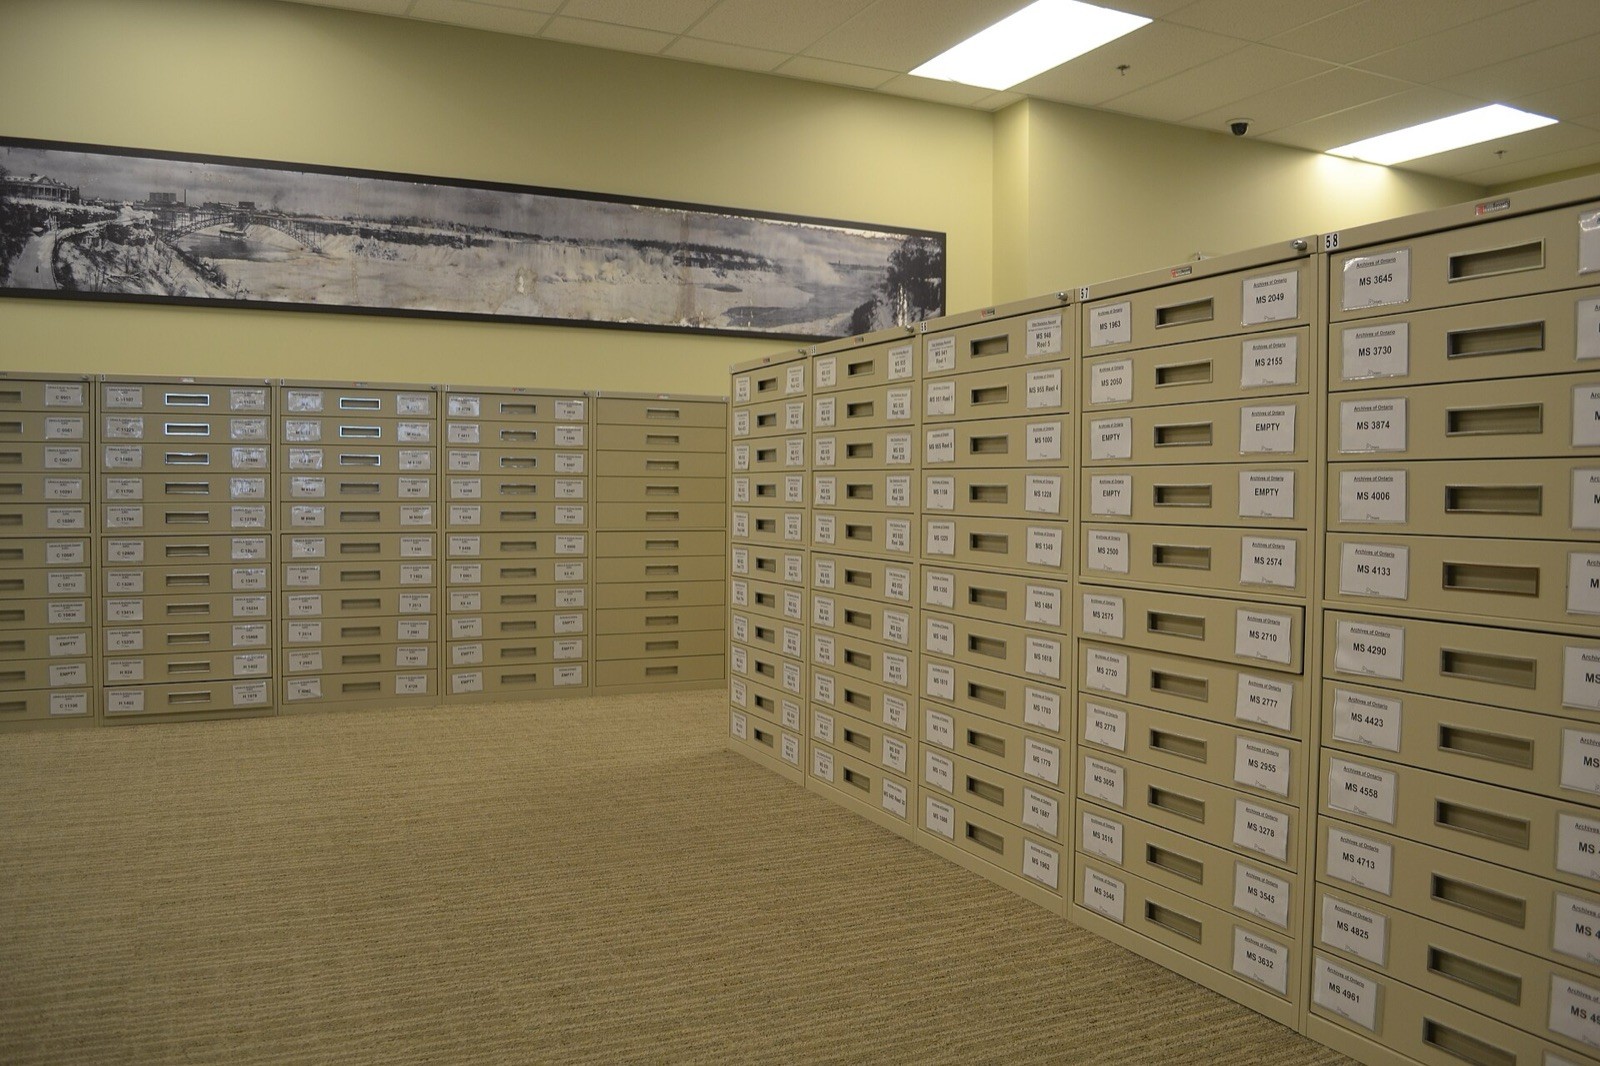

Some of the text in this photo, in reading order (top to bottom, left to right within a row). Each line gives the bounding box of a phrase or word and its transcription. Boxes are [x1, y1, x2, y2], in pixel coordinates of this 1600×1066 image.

[1325, 234, 1338, 248] 58
[1359, 273, 1393, 286] MS 3645
[1255, 292, 1285, 305] MS 2049
[1100, 320, 1121, 330] MS 1963
[1358, 345, 1392, 357] MS 3730
[1254, 357, 1283, 367] MS 2155
[1101, 378, 1123, 387] MS 2050
[1255, 423, 1280, 432] EMPTY
[1356, 420, 1390, 430] MS 3874
[1102, 433, 1121, 442] EMPTY
[1103, 489, 1121, 498] EMPTY
[1255, 488, 1279, 497] EMPTY
[1356, 491, 1390, 501] MS 4006
[1097, 547, 1106, 555] MS
[1254, 556, 1282, 567] MS 2574
[1357, 564, 1391, 576] MS 4133
[1093, 610, 1101, 618] MS
[1249, 630, 1277, 642] MS 2710
[1353, 643, 1387, 656] MS 4290
[1034, 653, 1041, 661] MS
[1096, 666, 1118, 677] MS 2720
[1585, 672, 1600, 684] MS
[1250, 695, 1278, 709] MS 2777
[1033, 704, 1040, 712] MS
[1095, 720, 1104, 729] MS
[1351, 712, 1384, 728] MS 4423
[1032, 755, 1040, 764] MS
[1583, 756, 1600, 768] MS
[1248, 758, 1276, 773] MS 2955
[1094, 775, 1102, 783] MS
[1345, 782, 1378, 799] MS 4558
[1031, 806, 1039, 814] MS
[1092, 830, 1101, 839] MS
[1247, 821, 1275, 838] MS 3278
[1578, 841, 1595, 854] MS
[1031, 857, 1039, 866] MS
[1342, 852, 1375, 870] MS 4713
[1094, 886, 1102, 895] MS
[1247, 886, 1275, 903] MS 3545
[1336, 920, 1369, 940] MS 4825
[1575, 923, 1592, 936] MS
[1246, 950, 1274, 969] MS 3632
[1328, 982, 1360, 1003] MS 4961
[1570, 1005, 1587, 1020] MS
